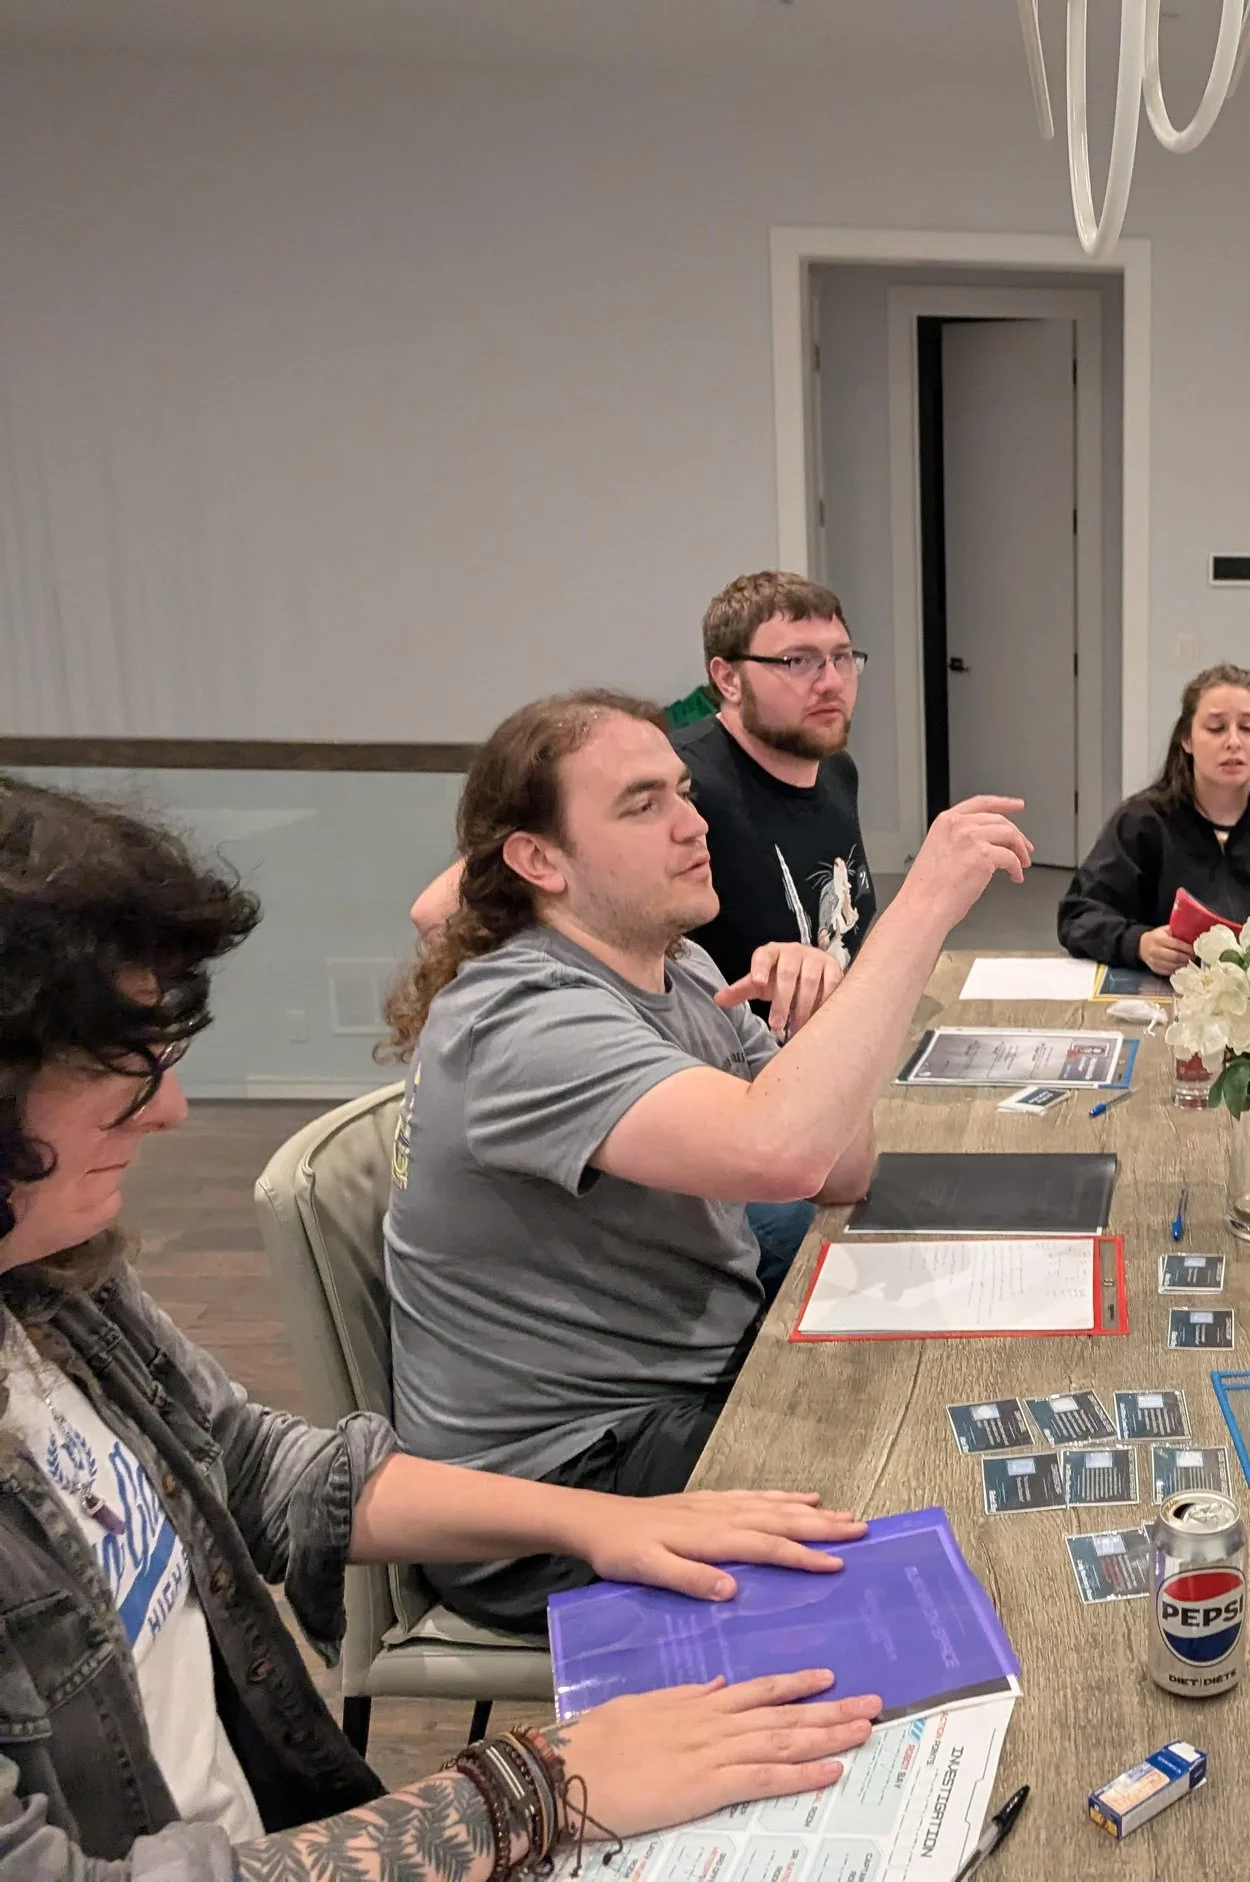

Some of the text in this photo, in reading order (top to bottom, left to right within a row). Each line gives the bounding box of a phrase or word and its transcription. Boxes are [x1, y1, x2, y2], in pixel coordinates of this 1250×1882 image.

[1162, 1595, 1244, 1627] PEPSI
[1169, 1674, 1199, 1687] DIET
[920, 1745, 964, 1858] INVESTIGATION
